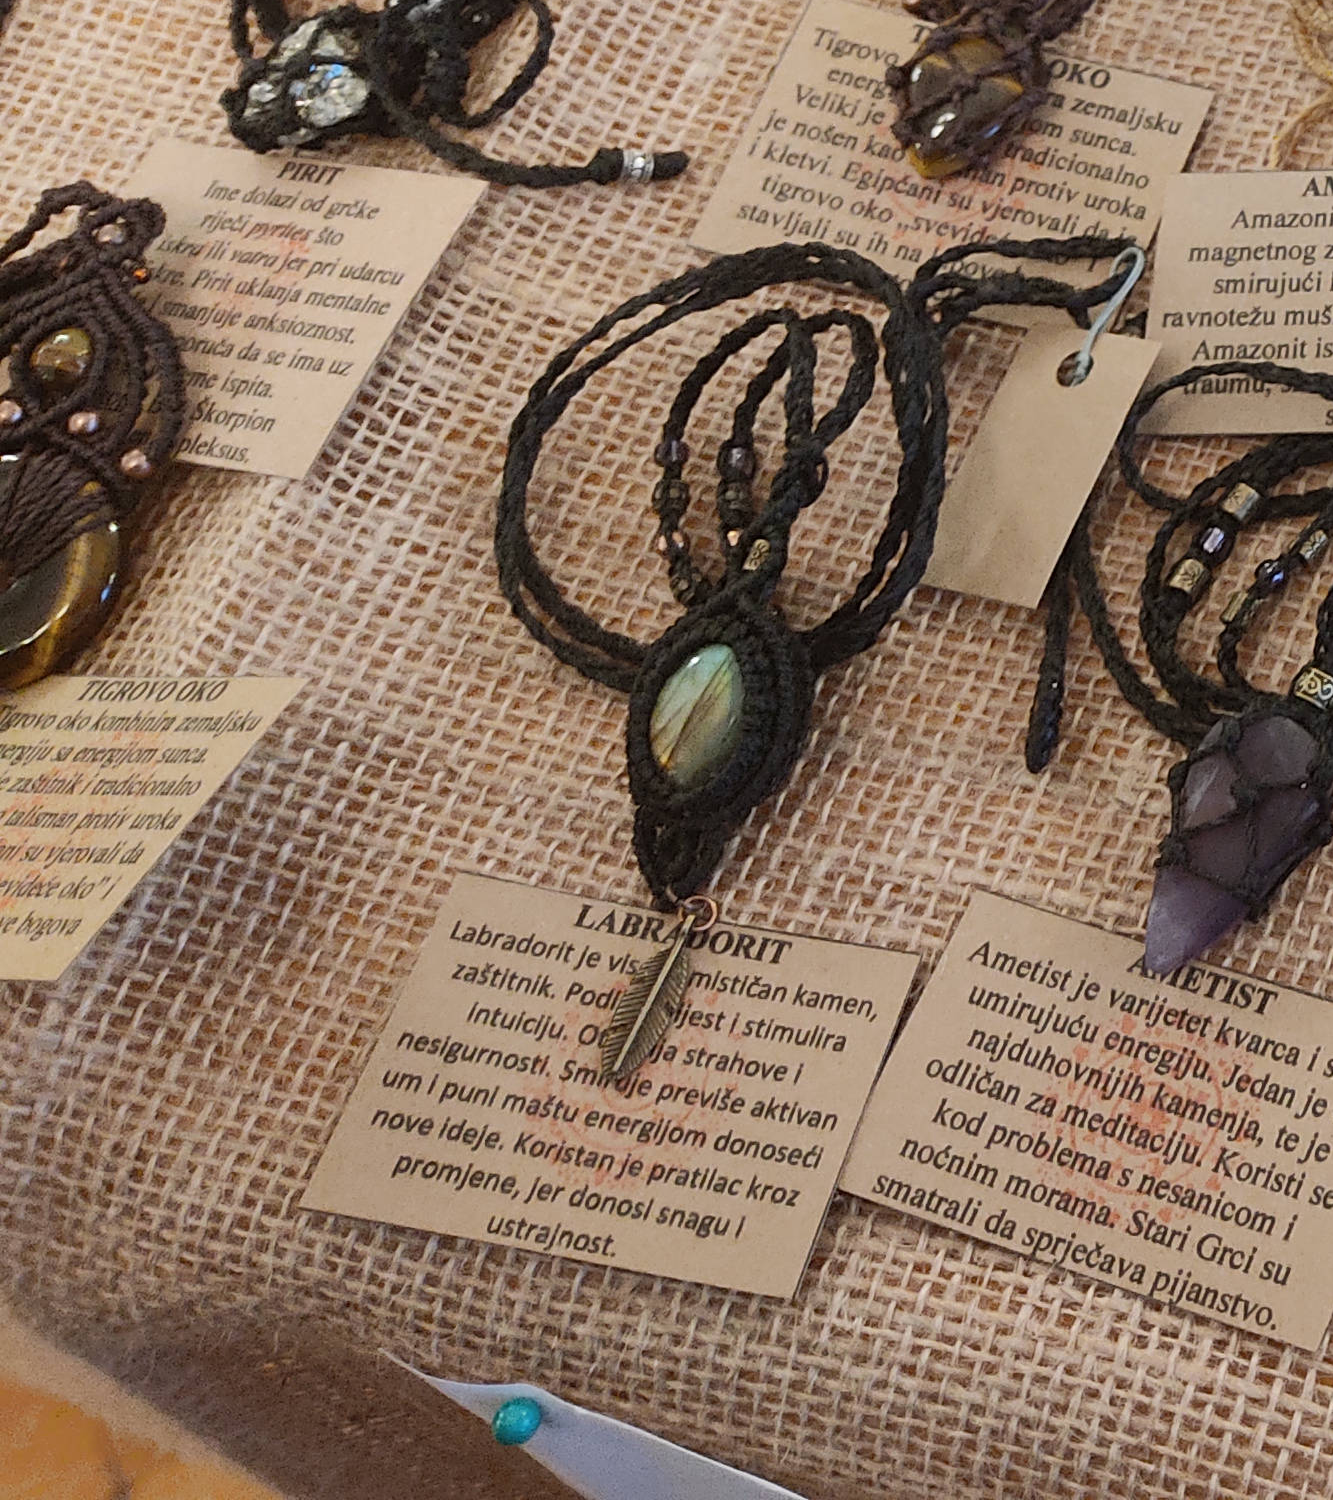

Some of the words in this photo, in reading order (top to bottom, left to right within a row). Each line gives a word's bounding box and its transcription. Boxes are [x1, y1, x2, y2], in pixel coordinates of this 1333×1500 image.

[1049, 59, 1114, 91] OKO
[796, 83, 861, 118] Veliki
[857, 102, 885, 125] je
[1068, 97, 1182, 134] zemaljsku
[276, 160, 345, 184] PIRIT
[747, 142, 757, 156] i
[762, 140, 831, 175] kletvi.
[841, 161, 948, 204] Egipćani
[947, 191, 972, 210] su
[981, 197, 1079, 235] vjerovali
[203, 180, 241, 201] Ime
[241, 185, 302, 209] dolazi
[299, 194, 329, 212] od
[322, 199, 379, 219] grčke
[199, 214, 249, 233] riječi
[313, 226, 344, 245] što
[736, 205, 831, 239] stavljali
[833, 230, 859, 247] su
[865, 231, 888, 255] ih
[893, 244, 922, 263] na
[203, 240, 230, 260] ili
[272, 249, 308, 273] jer
[304, 257, 340, 277] pri
[338, 261, 404, 285] udarcu
[1187, 242, 1316, 267] magnetnog
[1213, 270, 1322, 298] smirujući
[1161, 306, 1275, 328] ravnotežu
[192, 394, 276, 433] Škorpion
[76, 679, 178, 702] TIGROVO
[175, 679, 229, 702] OKO
[55, 709, 91, 731] oko
[88, 709, 176, 732] kombinira
[173, 710, 262, 737] zemaljsku
[53, 746, 72, 762] sa
[73, 742, 157, 768] energijom
[155, 747, 208, 763] sunca.
[3, 805, 79, 829] talisman
[69, 810, 131, 835] protiv
[128, 807, 182, 830] uroka
[967, 941, 1071, 991] Ametist
[1066, 972, 1100, 1002] je
[1109, 988, 1212, 1041] varijetet
[1213, 1016, 1300, 1066] kvarca
[1306, 1046, 1321, 1071] i
[966, 1029, 1145, 1103] najduhovnijih
[1149, 1081, 1263, 1147] kamenja,
[1274, 1125, 1299, 1152] te
[1296, 1131, 1330, 1164] je
[382, 1069, 422, 1093] um
[426, 1073, 439, 1094] i
[438, 1081, 499, 1107] puni
[501, 1093, 579, 1122] maštu
[584, 1110, 706, 1147] energijom
[713, 1129, 823, 1169] donoseći
[925, 1059, 1020, 1105] odličan
[1024, 1092, 1057, 1118] za
[1059, 1104, 1201, 1167] meditaciju.
[1211, 1146, 1303, 1199] Koristi
[370, 1109, 434, 1135] nove
[437, 1116, 503, 1151] ideje.
[513, 1131, 615, 1172] Koristan
[613, 1152, 643, 1180] je
[645, 1163, 742, 1195] pratilac
[745, 1174, 800, 1207] kroz
[486, 1215, 615, 1257] ustrajnost.
[871, 1174, 978, 1226] smatrali
[984, 1208, 1016, 1240] da
[1021, 1227, 1146, 1284] sprječava
[1148, 1268, 1276, 1330] pijanstvo.
